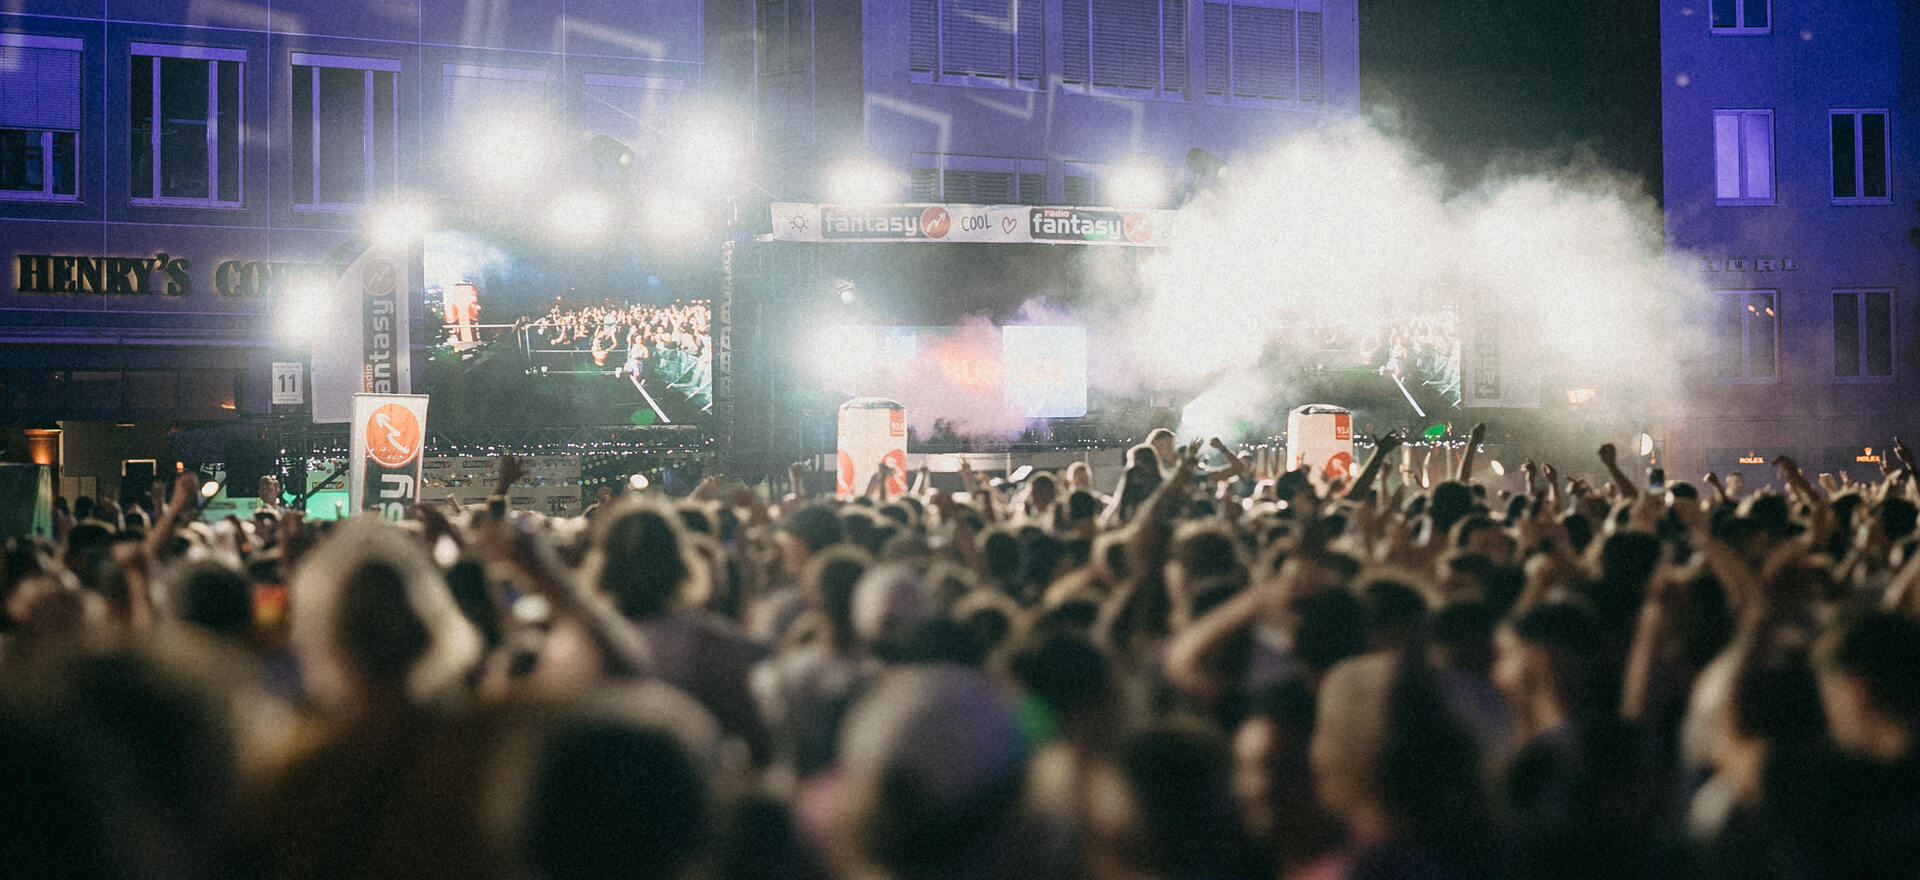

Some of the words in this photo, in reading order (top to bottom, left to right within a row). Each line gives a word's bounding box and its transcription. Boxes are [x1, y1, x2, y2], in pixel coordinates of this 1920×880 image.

[825, 206, 918, 237] fantasy
[961, 213, 993, 232] COOL
[1044, 209, 1070, 217] radio
[1032, 212, 1122, 240] fantasy
[16, 253, 192, 297] HENRY'S
[368, 299, 394, 394] antasy
[278, 374, 296, 393] 11
[1739, 456, 1764, 464] ROLEX
[1856, 455, 1880, 463] ROLEX
